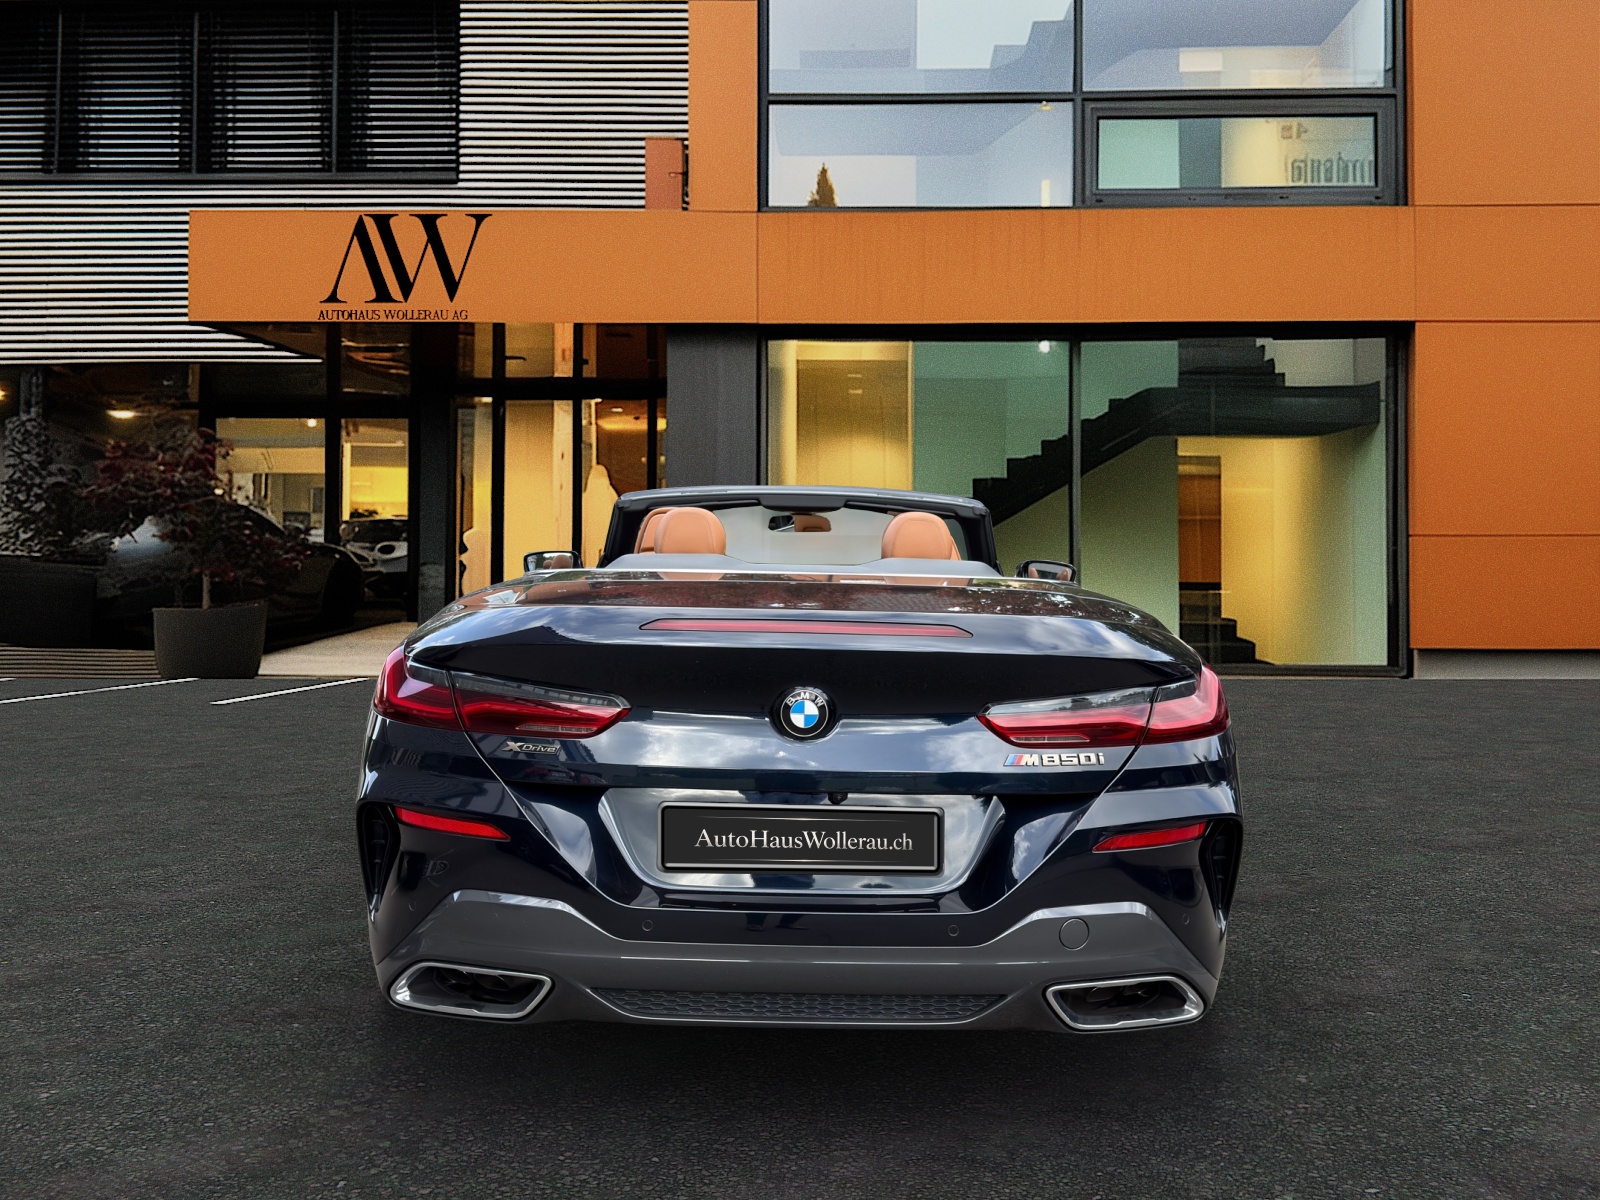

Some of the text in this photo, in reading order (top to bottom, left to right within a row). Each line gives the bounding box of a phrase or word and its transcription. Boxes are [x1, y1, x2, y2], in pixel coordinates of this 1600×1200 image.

[319, 213, 493, 304] AW
[317, 309, 469, 321] AUTOHAUS WOLLERAU AG
[785, 691, 825, 708] BMW
[1004, 752, 1105, 767] M850i
[694, 828, 914, 851] AutoHausWollerau.ch
